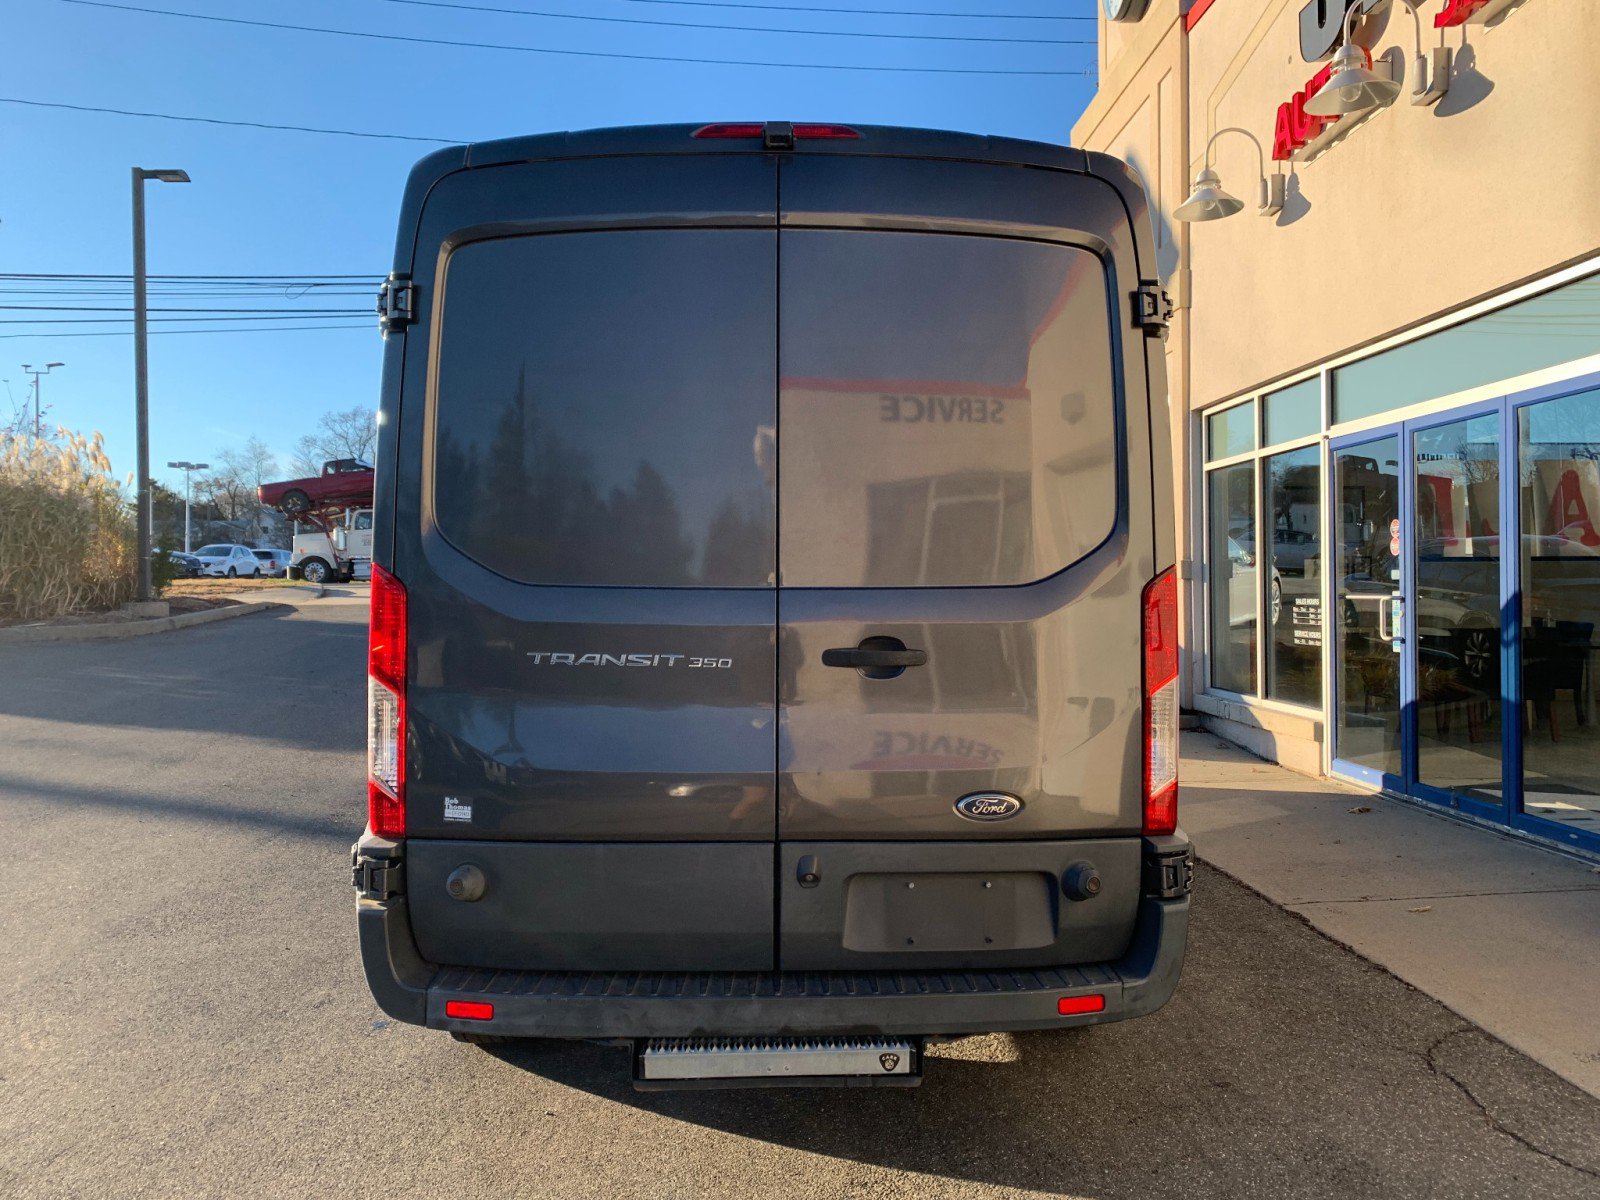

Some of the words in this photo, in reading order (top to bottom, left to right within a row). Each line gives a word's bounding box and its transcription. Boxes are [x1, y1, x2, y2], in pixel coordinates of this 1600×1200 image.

[526, 652, 685, 667] TRANSIT
[688, 657, 732, 669] 350
[444, 803, 472, 811] Thomas
[971, 799, 1008, 815] Ford
